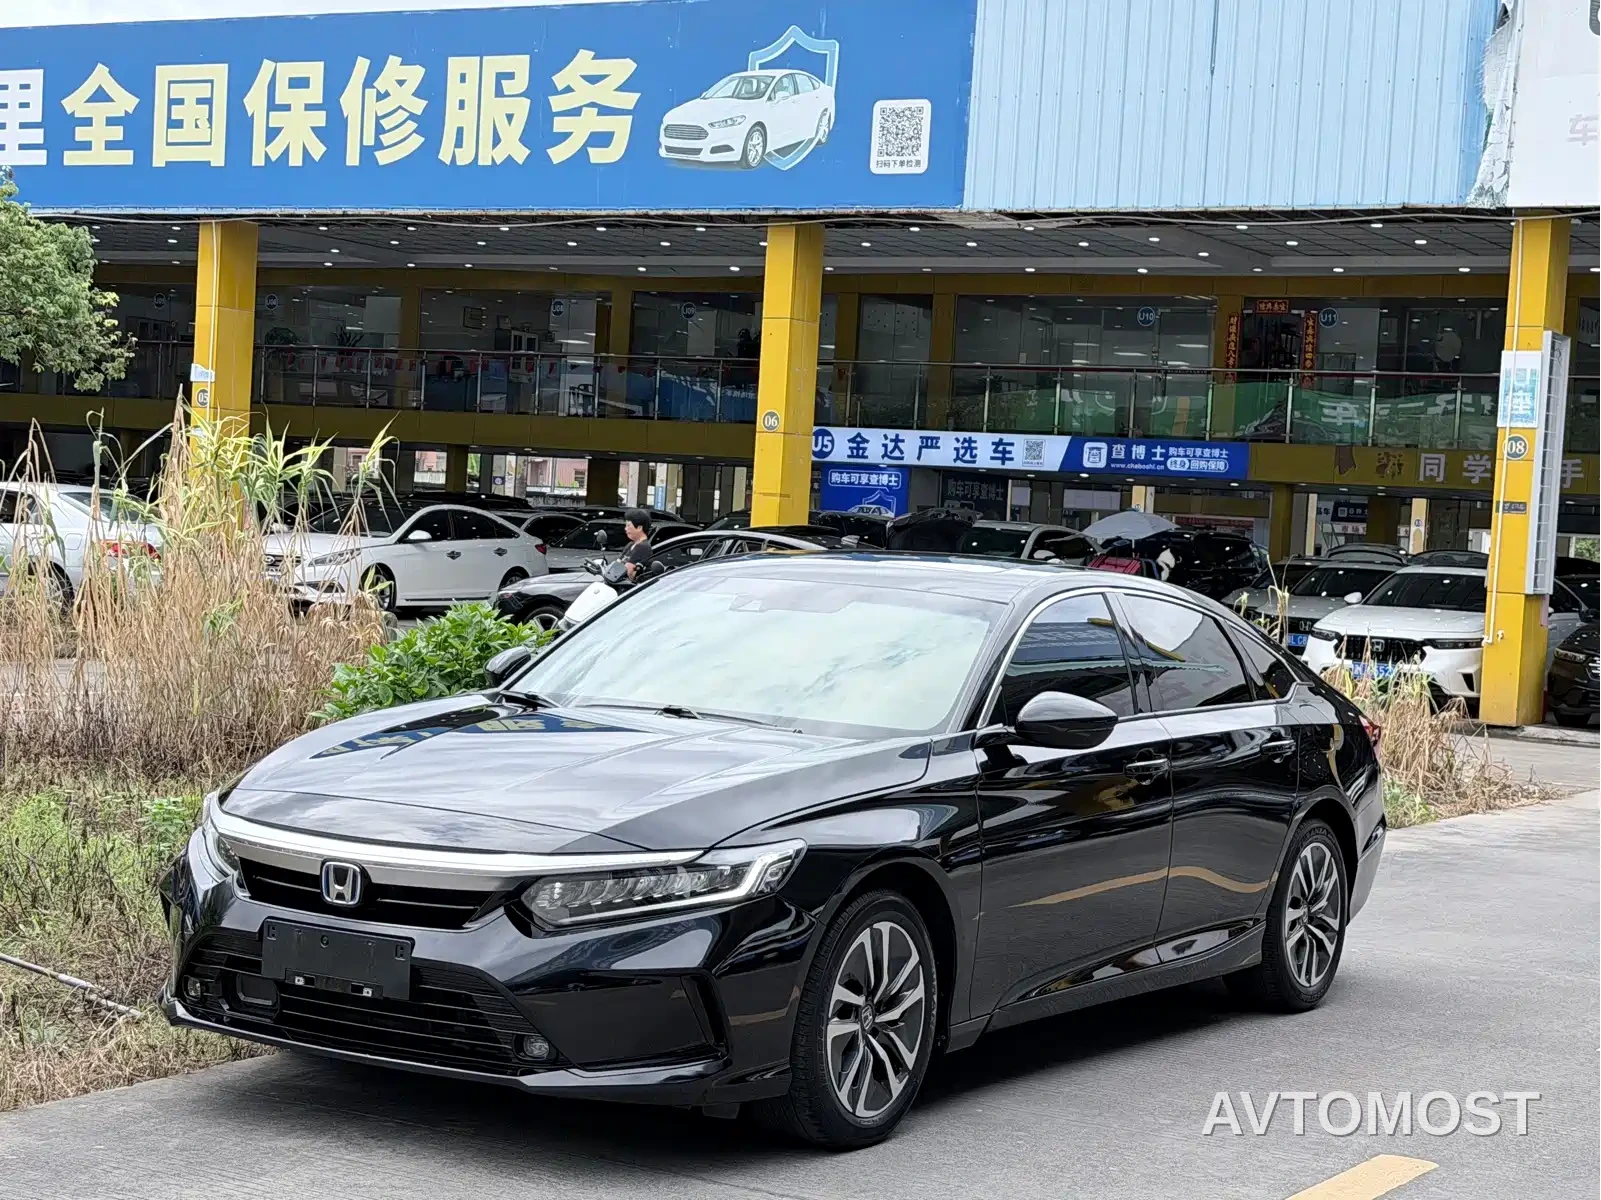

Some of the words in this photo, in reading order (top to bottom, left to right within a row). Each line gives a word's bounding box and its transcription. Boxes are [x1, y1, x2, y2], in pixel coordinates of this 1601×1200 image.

[876, 159, 922, 168] 扫码下单检测
[1138, 312, 1154, 321] U10
[1320, 313, 1337, 322] U11
[764, 415, 778, 428] 06
[846, 431, 1016, 466] 金达严选车
[1111, 443, 1166, 461] 查博士
[1168, 446, 1229, 459] 购车可享查博士
[1507, 440, 1525, 455] 08
[830, 472, 900, 486] 购车可享查博士
